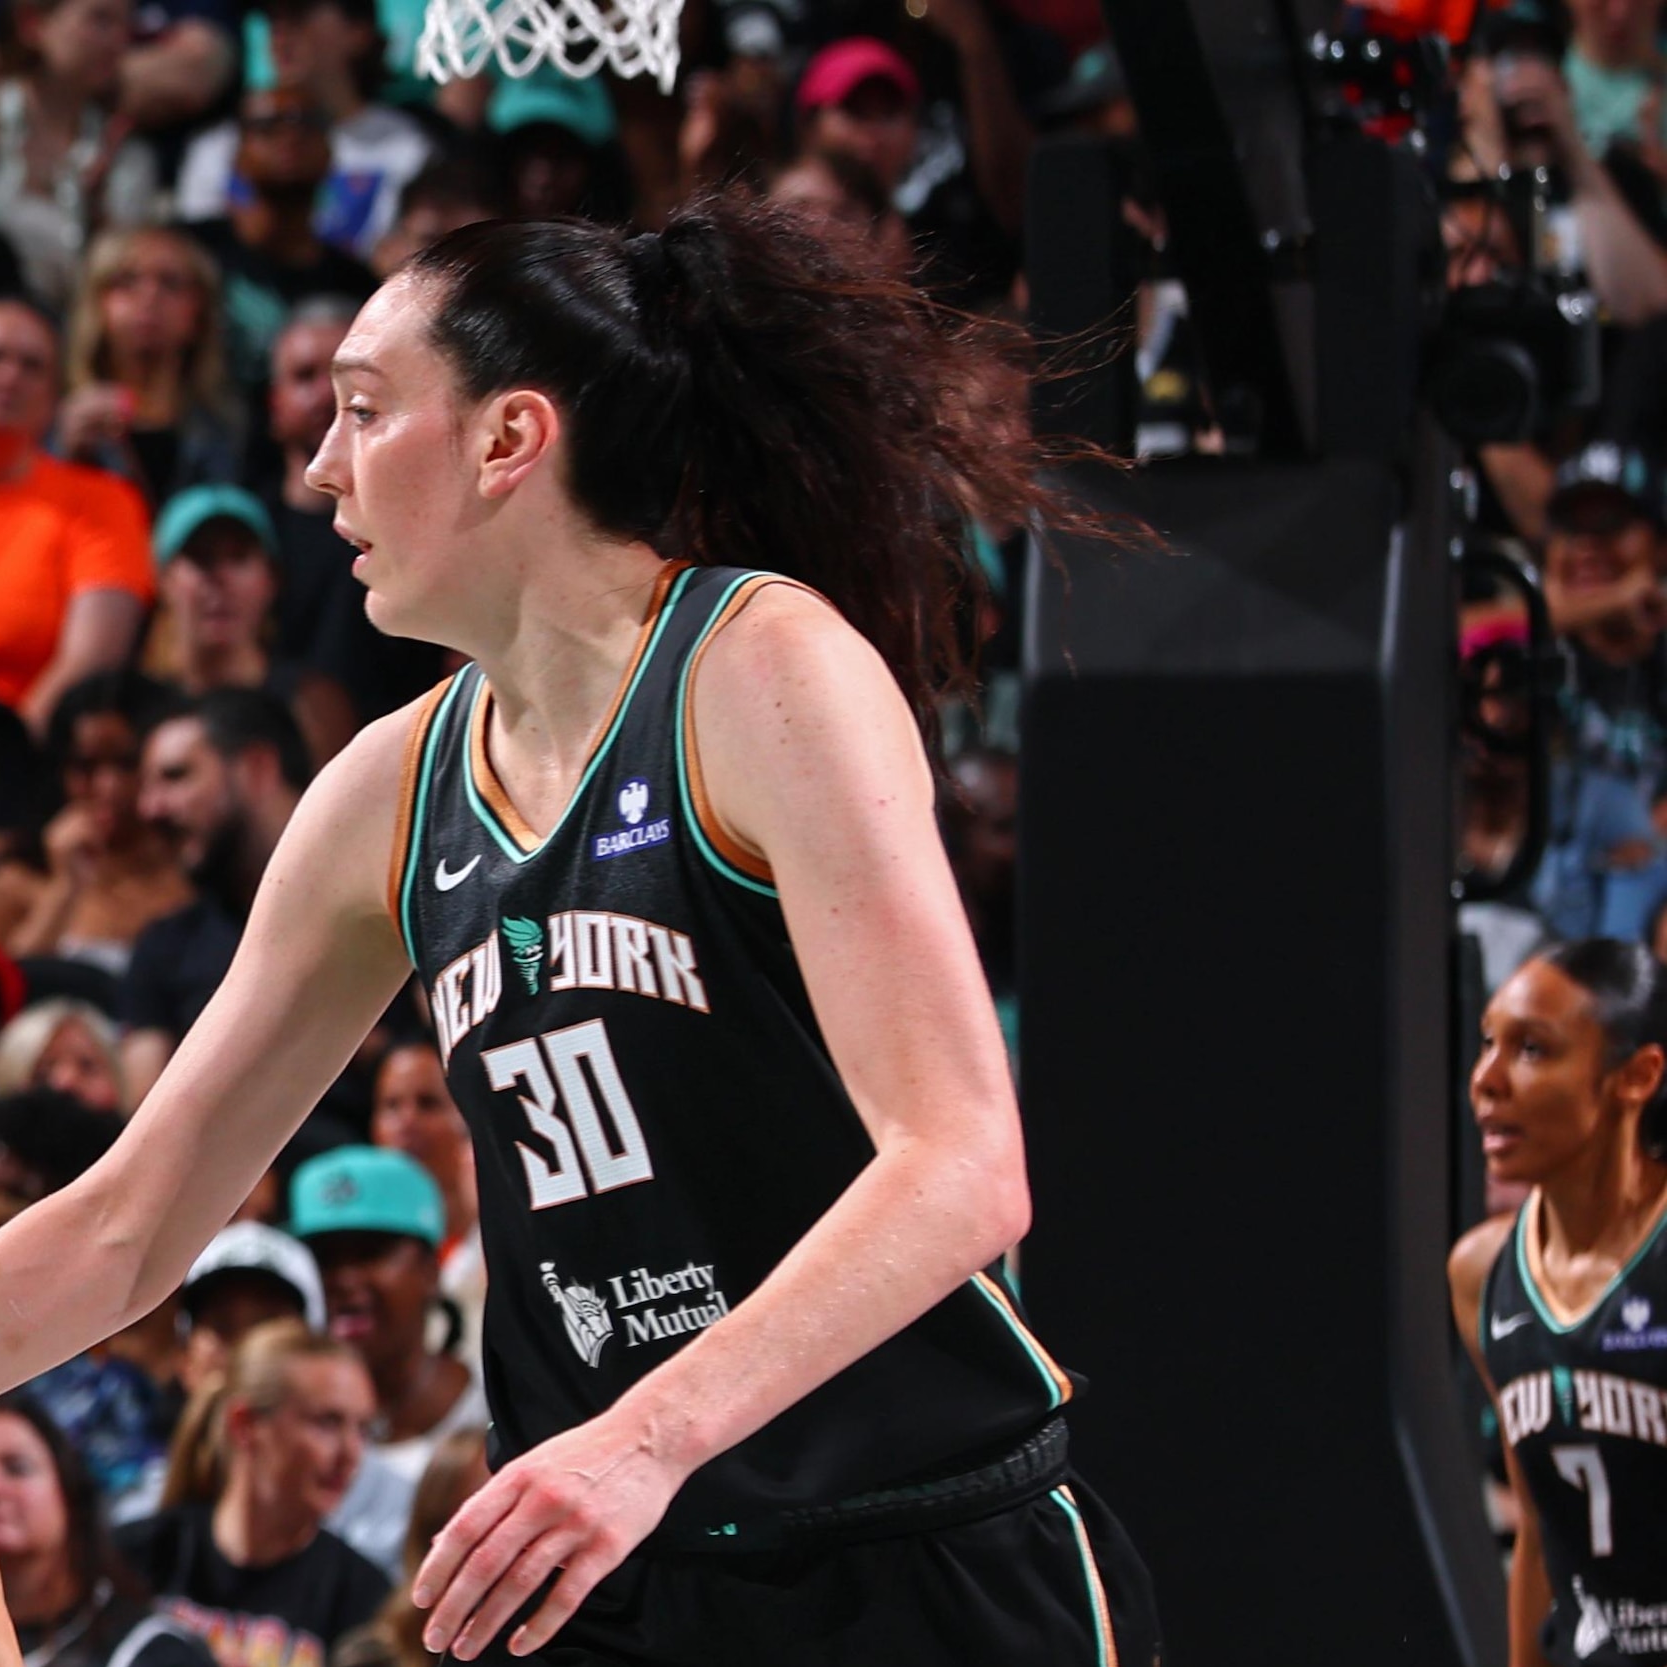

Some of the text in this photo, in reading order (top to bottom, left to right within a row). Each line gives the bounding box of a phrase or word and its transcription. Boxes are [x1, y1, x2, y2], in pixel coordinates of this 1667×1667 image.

[596, 818, 670, 857] BARCLAYS
[547, 909, 711, 1015] YORK
[479, 1017, 655, 1211] 30
[606, 1261, 715, 1310] Liberty
[621, 1291, 730, 1348] Mutual
[1499, 1368, 1667, 1450] EW YOR
[1550, 1443, 1613, 1557] 7
